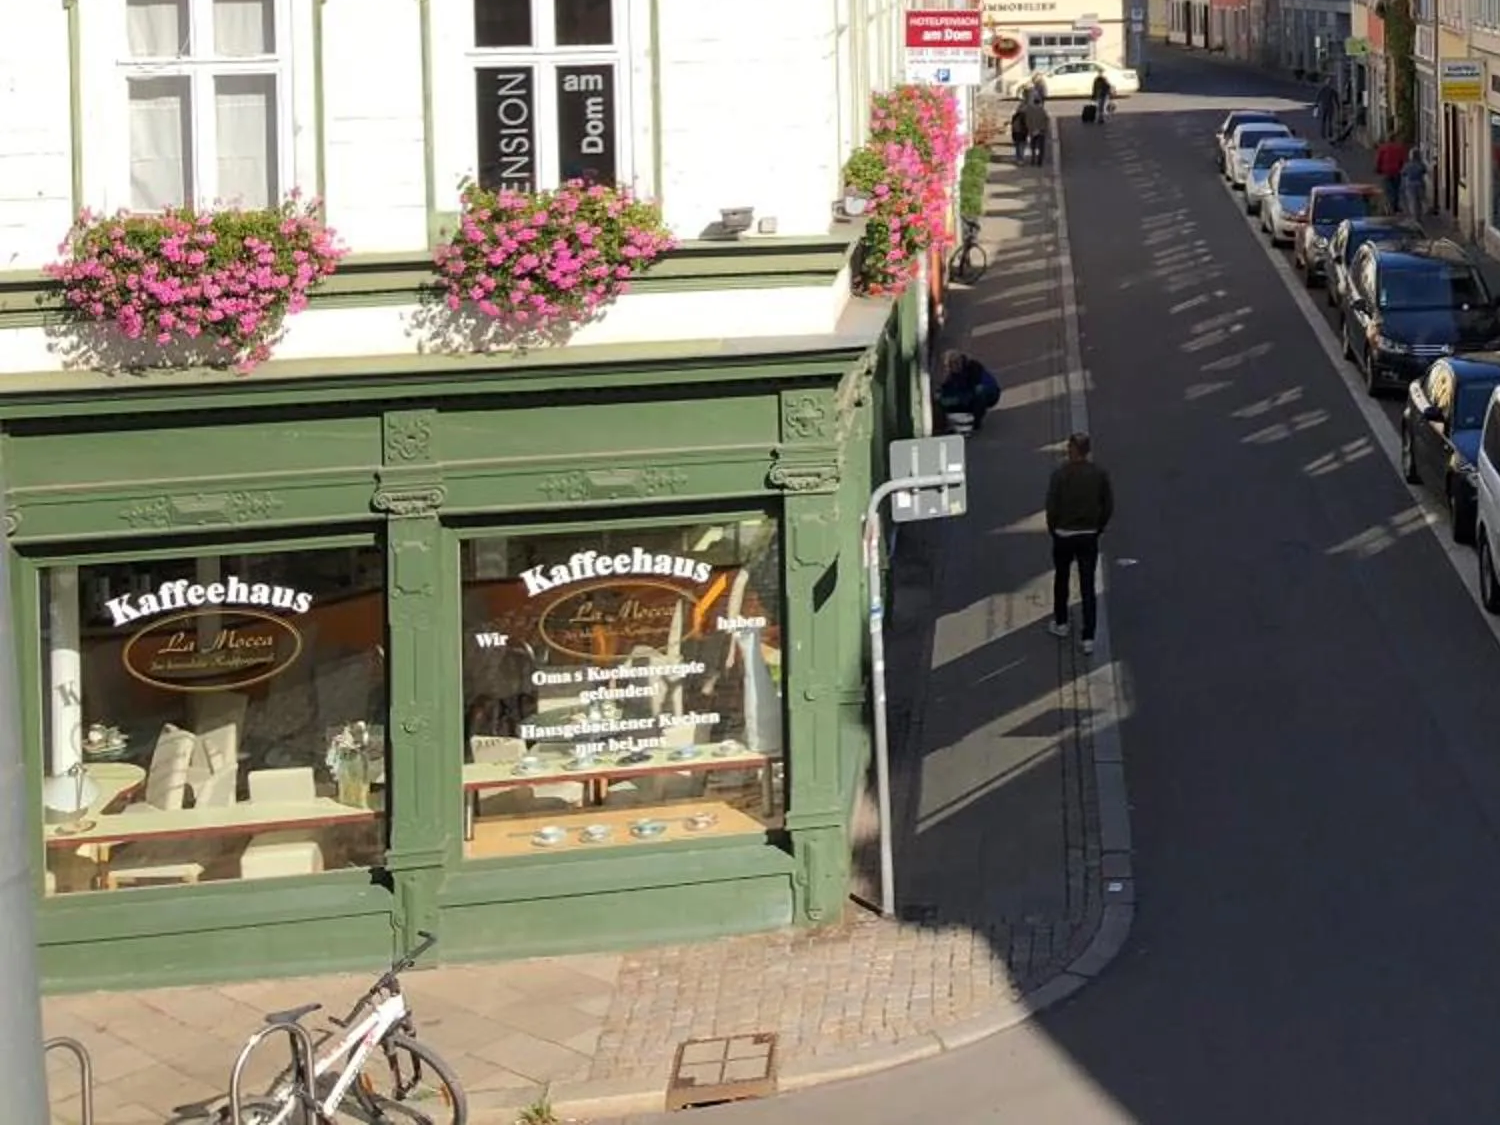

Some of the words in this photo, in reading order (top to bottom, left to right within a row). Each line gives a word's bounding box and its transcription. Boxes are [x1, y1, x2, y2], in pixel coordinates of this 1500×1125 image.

[922, 30, 942, 41] am
[944, 28, 973, 42] Dom
[563, 75, 602, 92] am
[581, 97, 604, 154] Dom
[520, 547, 713, 597] Kaffeehaus
[104, 576, 313, 627] Kaffeehaus
[158, 631, 196, 654] La
[200, 629, 274, 654] Mocca
[476, 632, 508, 648] Wir
[717, 615, 766, 631] haben
[586, 661, 706, 682] Kuchenrezepte
[520, 716, 657, 739] Hausgebackener
[658, 711, 721, 728] Kuchen
